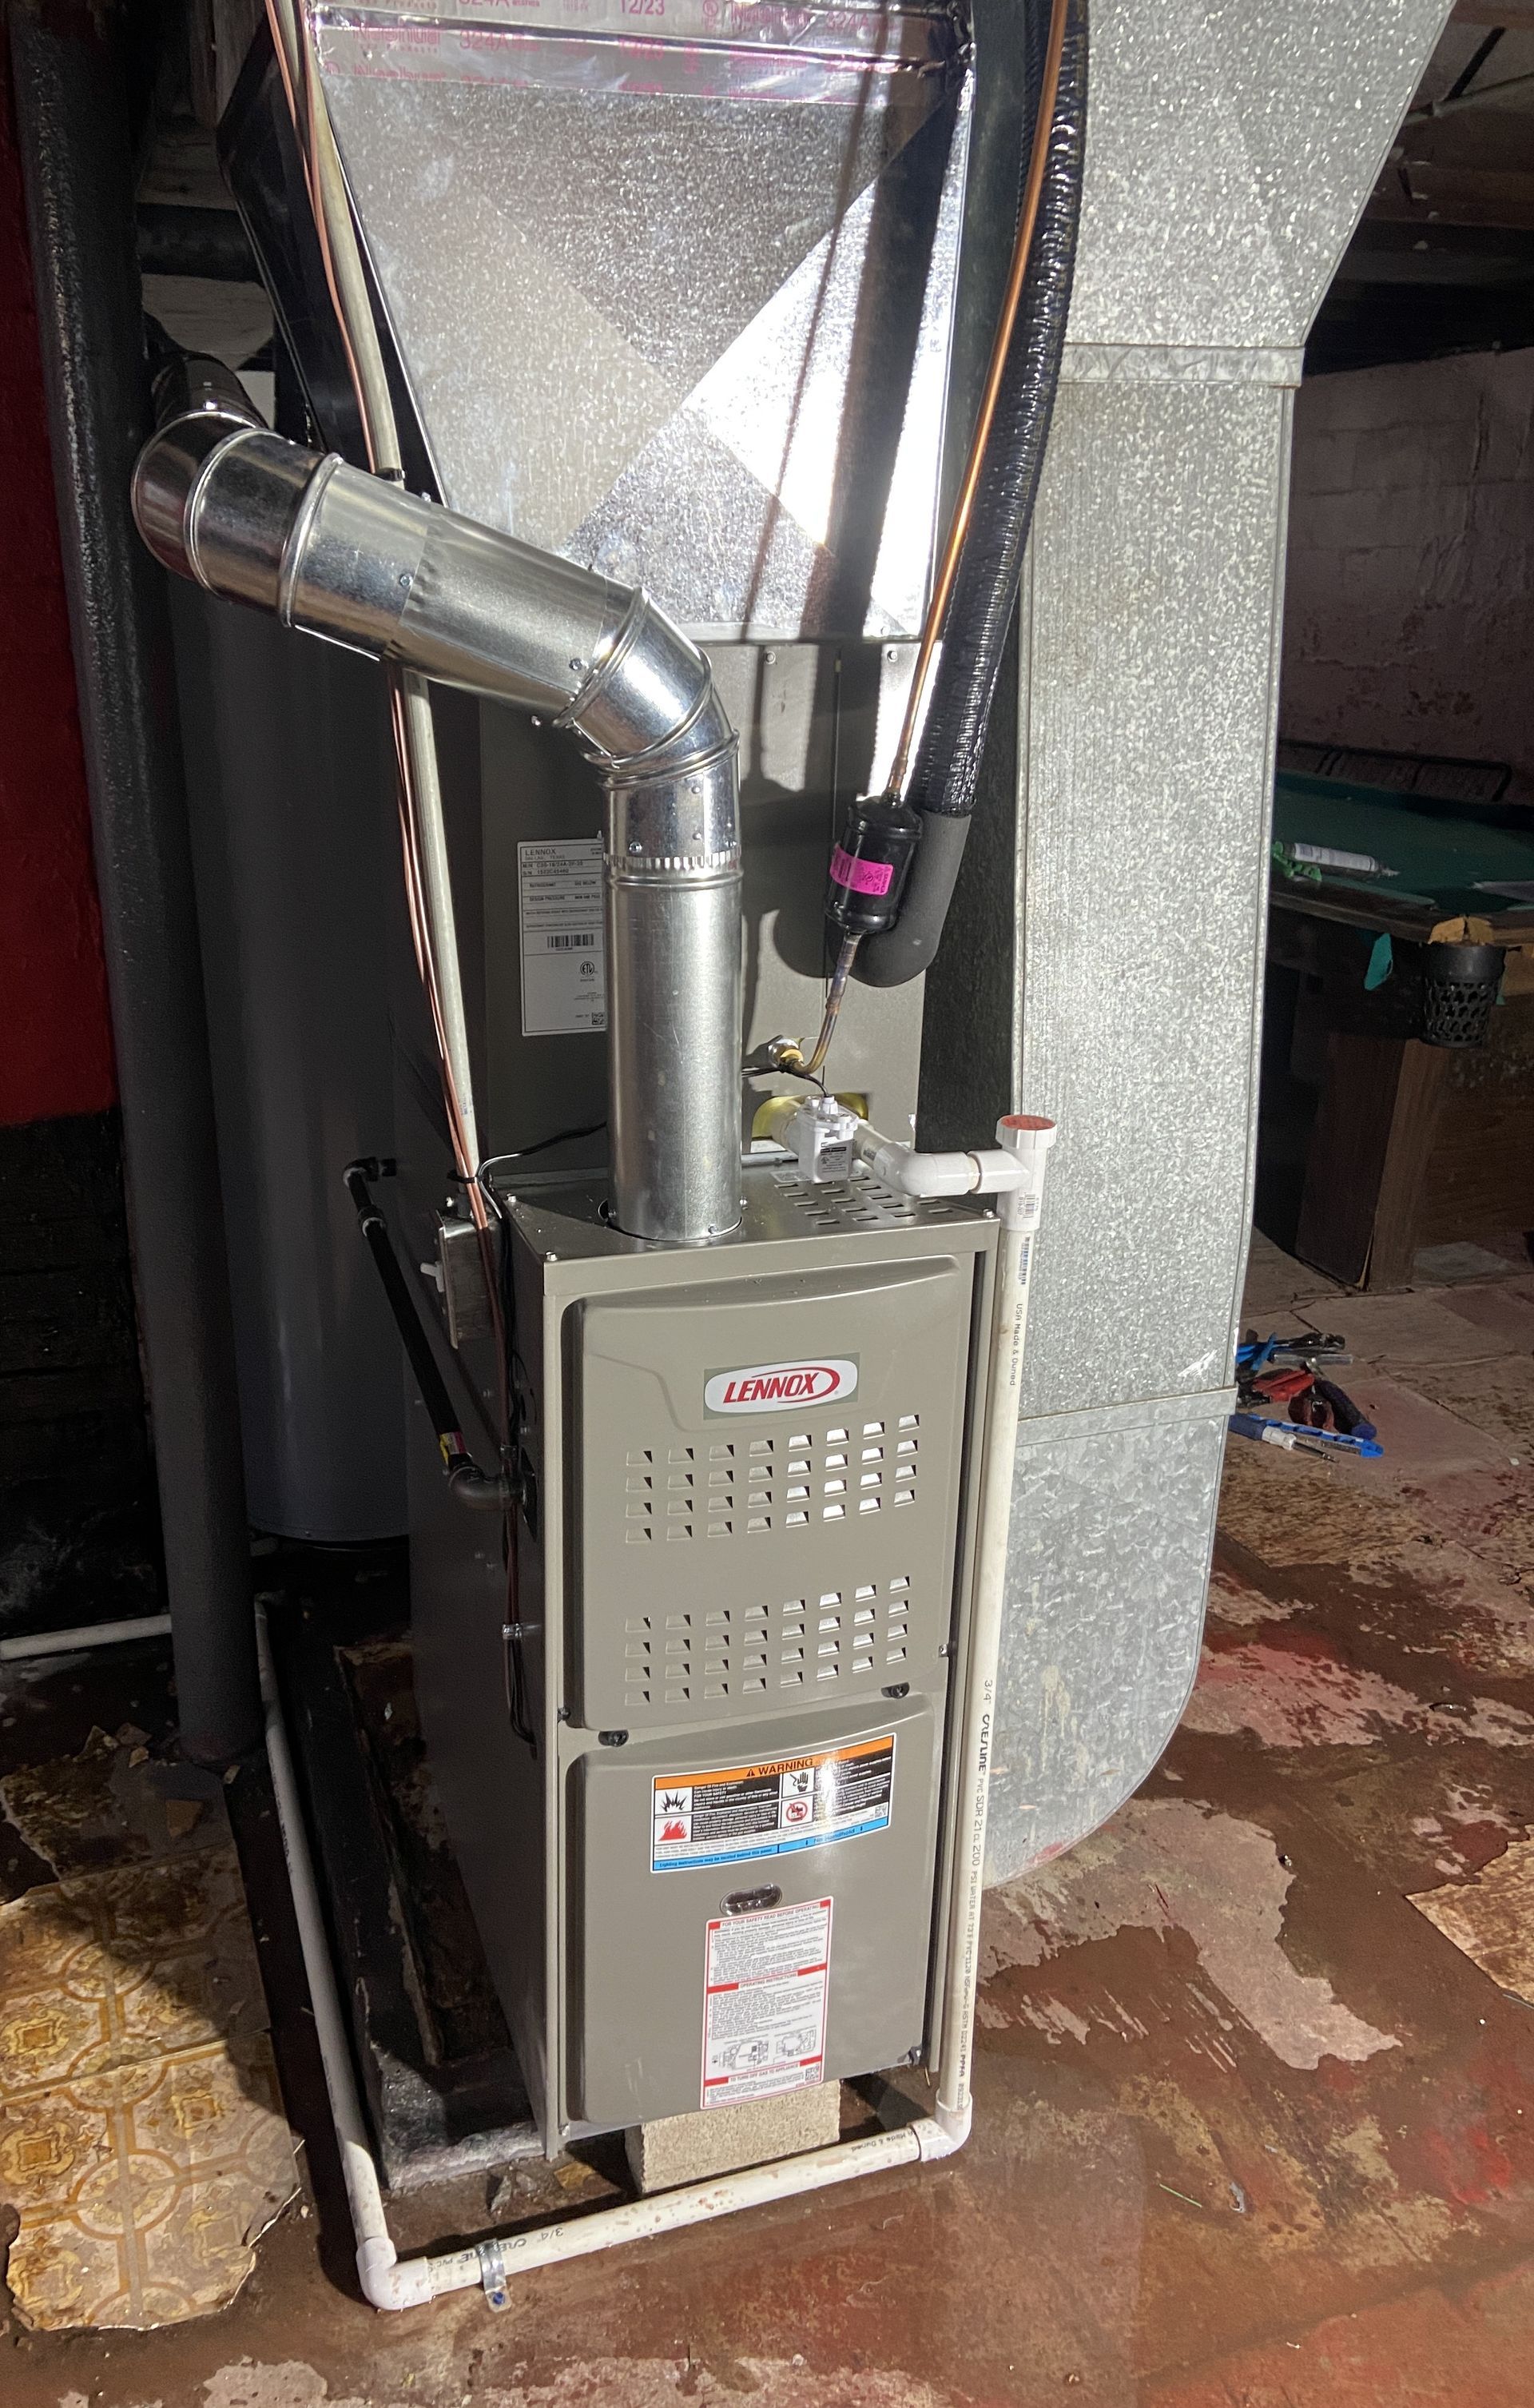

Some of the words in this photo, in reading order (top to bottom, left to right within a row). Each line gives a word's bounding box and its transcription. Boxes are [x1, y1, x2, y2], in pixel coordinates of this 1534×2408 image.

[460, 30, 509, 50] 324A
[1010, 1358, 1019, 1386] Owned
[723, 1372, 820, 1403] LENNOX
[979, 1713, 990, 1771] CRESLINE
[758, 1758, 813, 1777] WARNING
[976, 1795, 984, 1817] SDR
[973, 1820, 982, 1831] 21
[972, 1845, 981, 1866] 200
[437, 2257, 453, 2267] PVC
